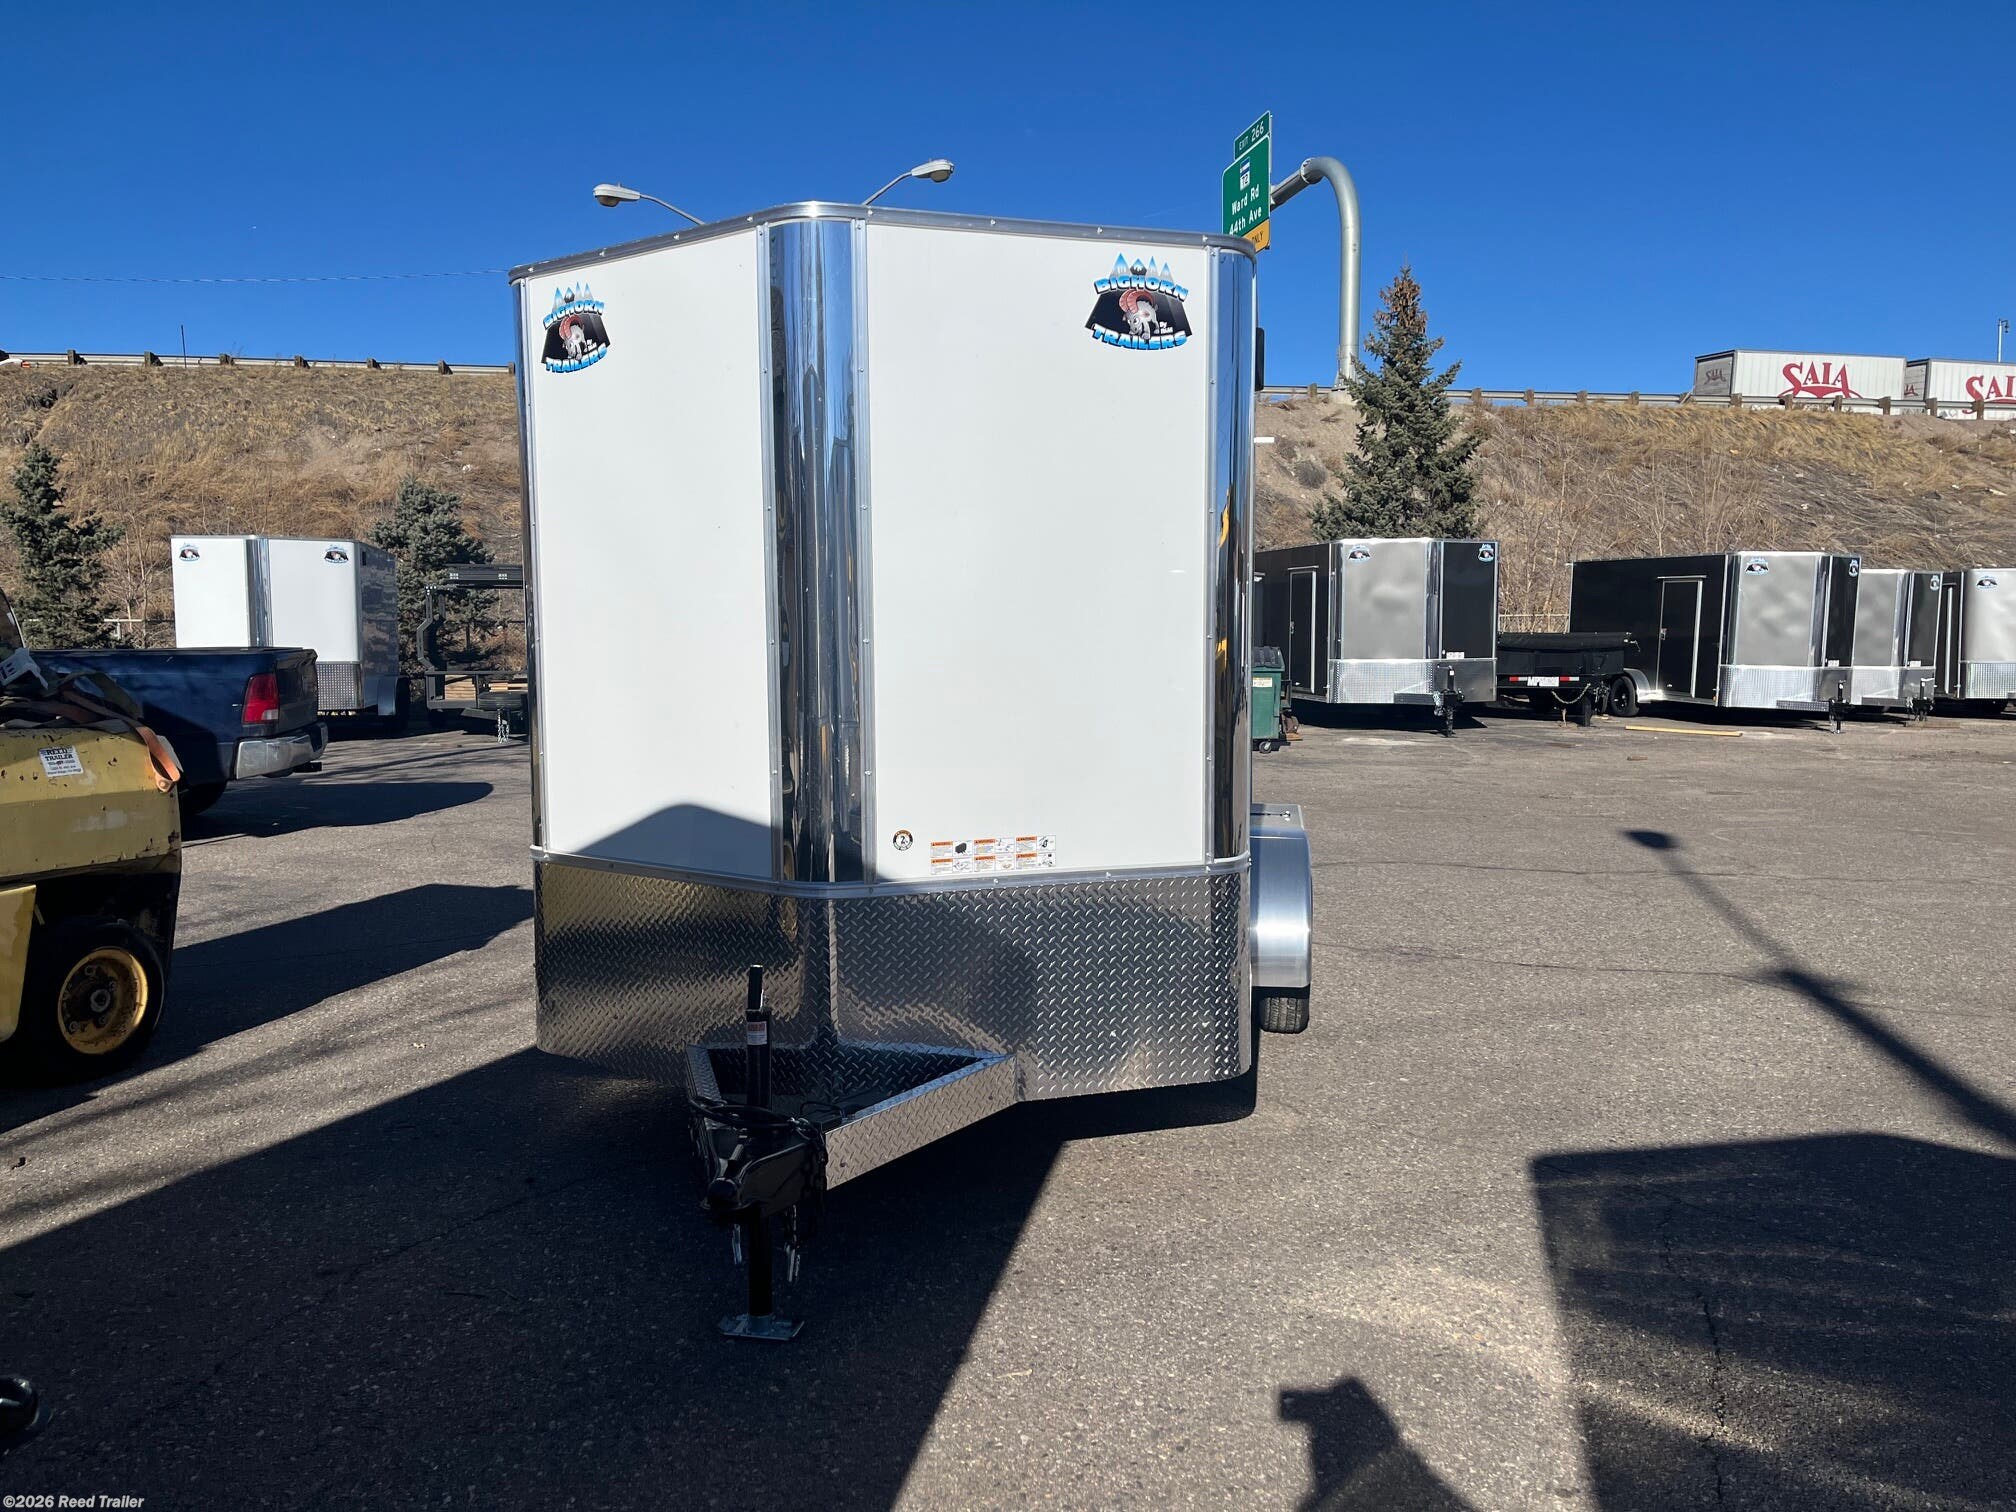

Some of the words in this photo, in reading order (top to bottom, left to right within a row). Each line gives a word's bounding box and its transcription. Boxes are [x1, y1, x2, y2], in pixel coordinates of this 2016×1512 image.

[1251, 121, 1264, 142] 266
[1231, 193, 1248, 215] Ward
[1250, 184, 1260, 203] Rd
[1229, 216, 1246, 236] 44th
[1249, 207, 1262, 224] Ave
[1093, 274, 1189, 302] BIGHORN
[543, 299, 605, 331] BIGHORN
[1091, 322, 1188, 351] TRAILERS
[545, 342, 608, 374] TRAILERS
[1778, 361, 1860, 399] SAIA
[44, 754, 74, 762] TRAILER
